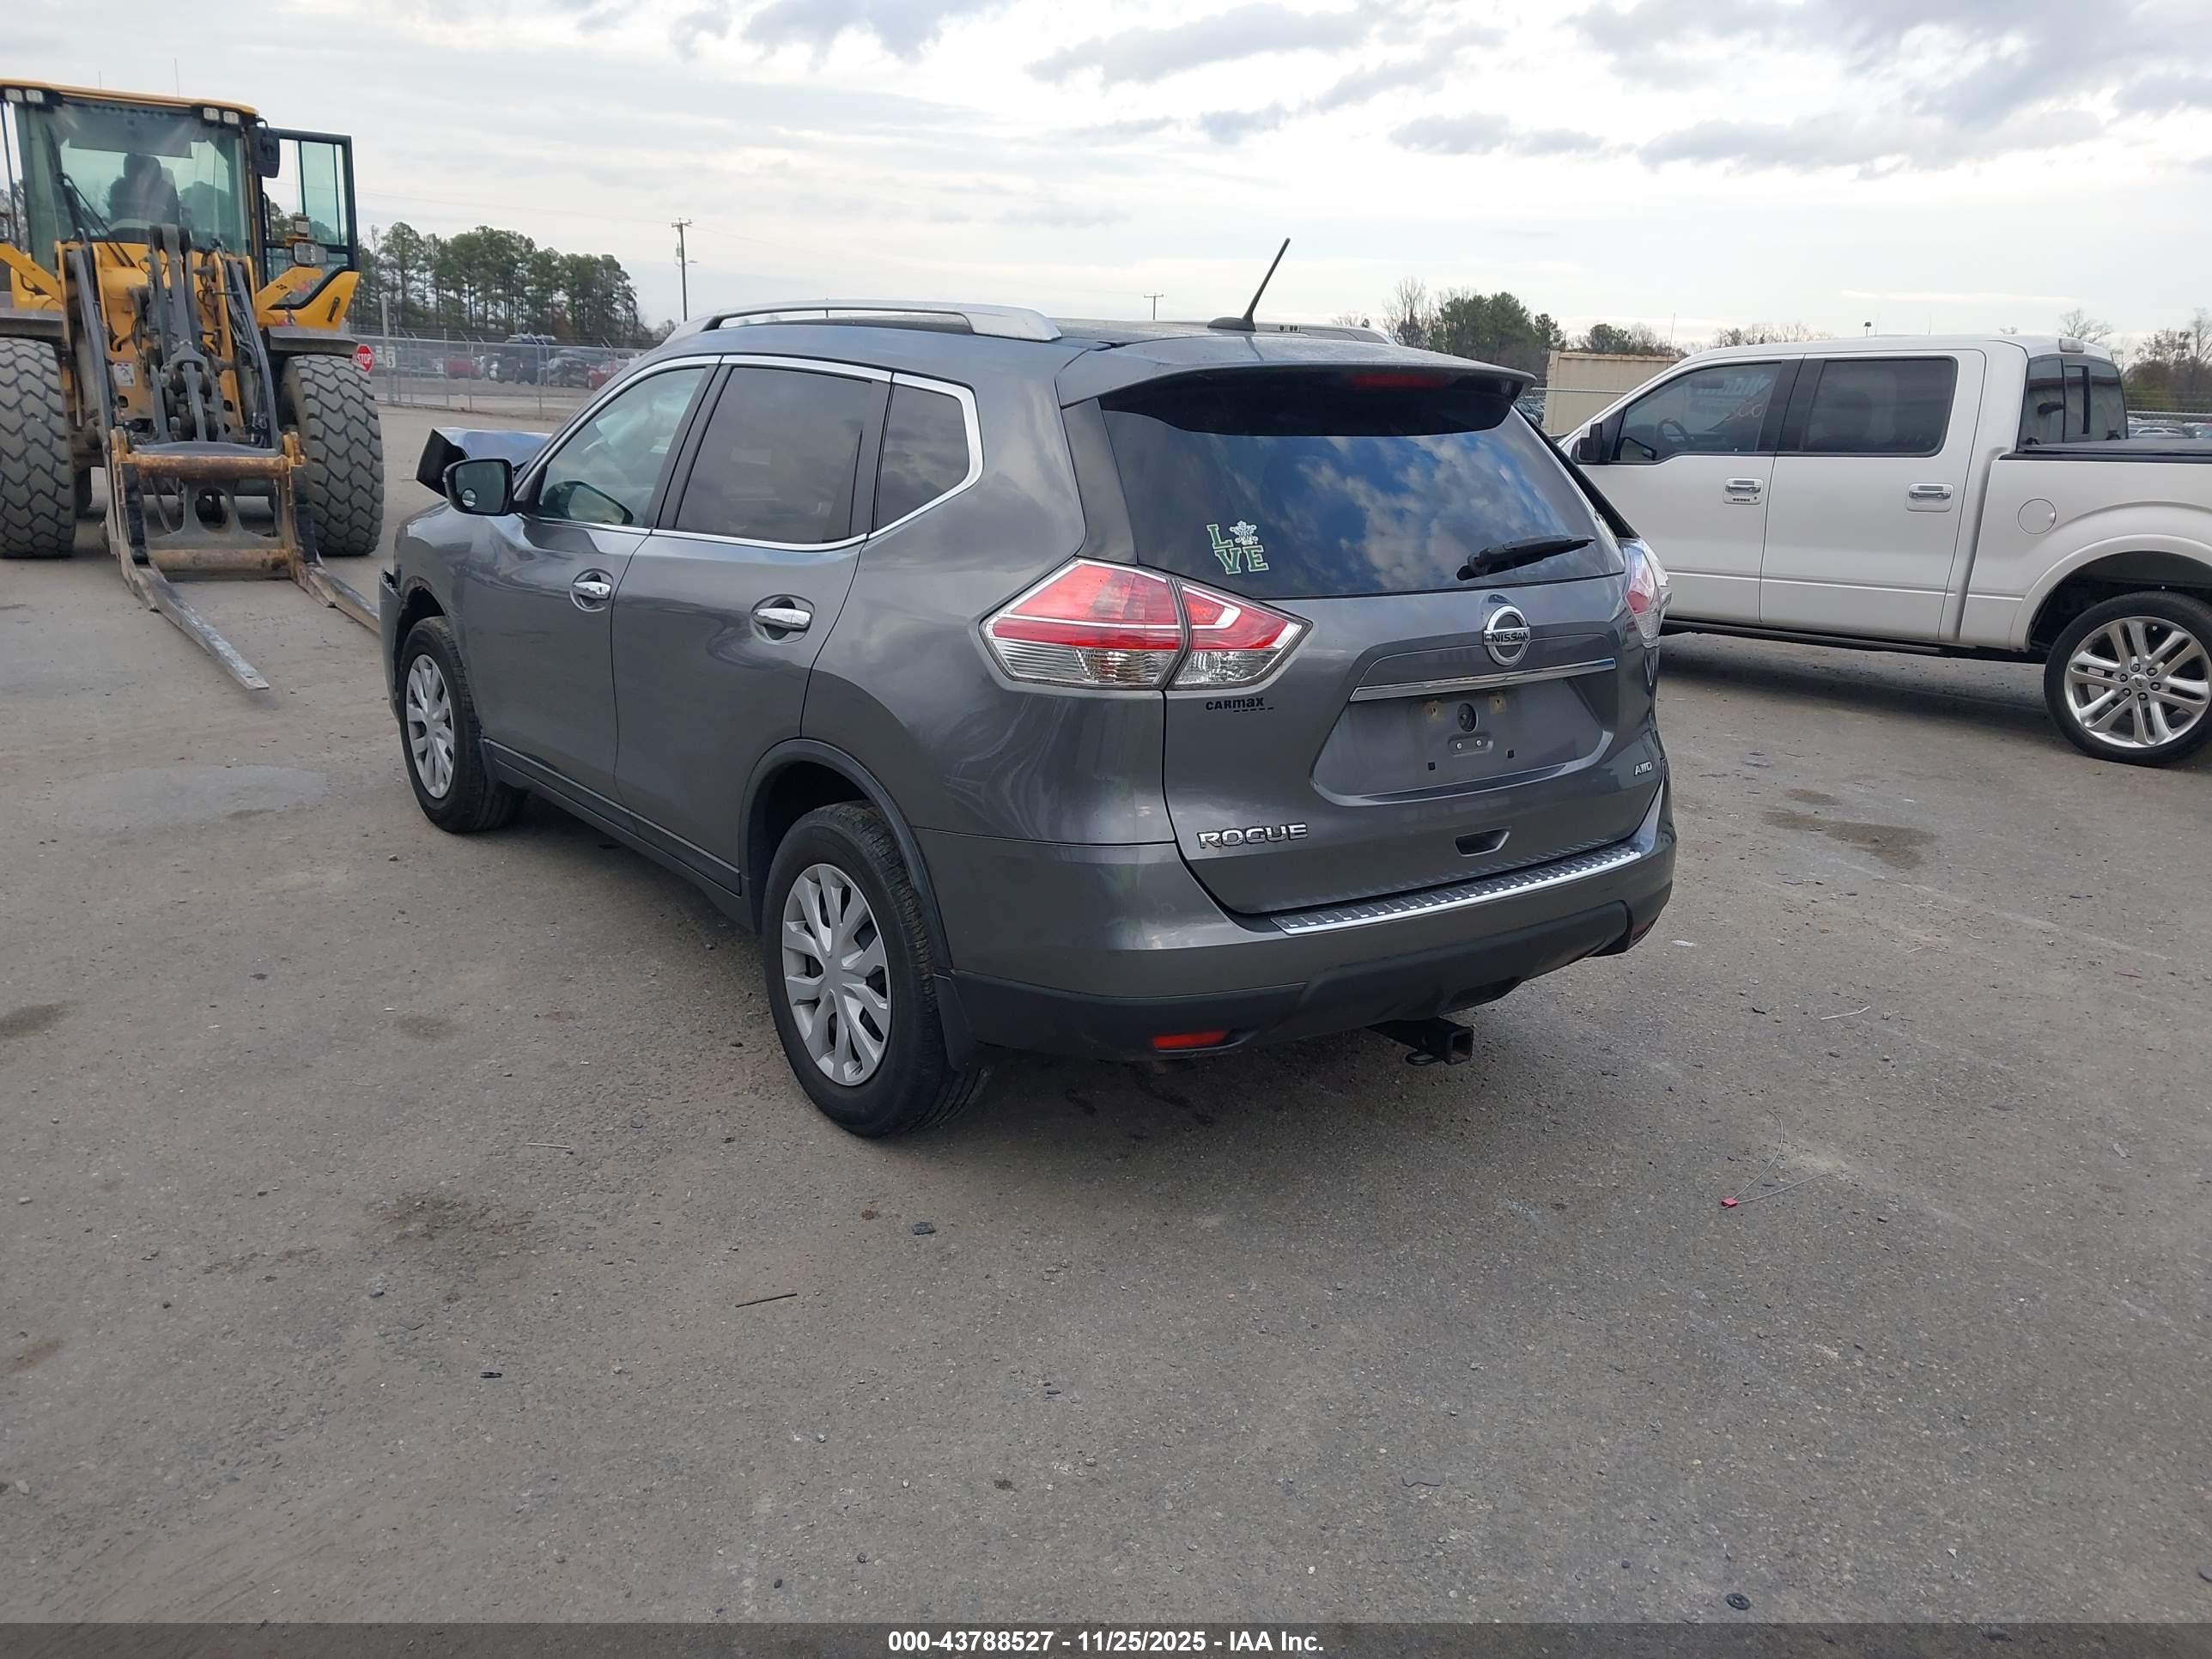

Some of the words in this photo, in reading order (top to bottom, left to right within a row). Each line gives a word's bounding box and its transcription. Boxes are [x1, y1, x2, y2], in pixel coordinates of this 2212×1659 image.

[356, 353, 372, 365] STOP
[1492, 631, 1528, 642] NISSAN
[1634, 762, 1653, 775] AWD
[1197, 823, 1308, 848] ROGUE
